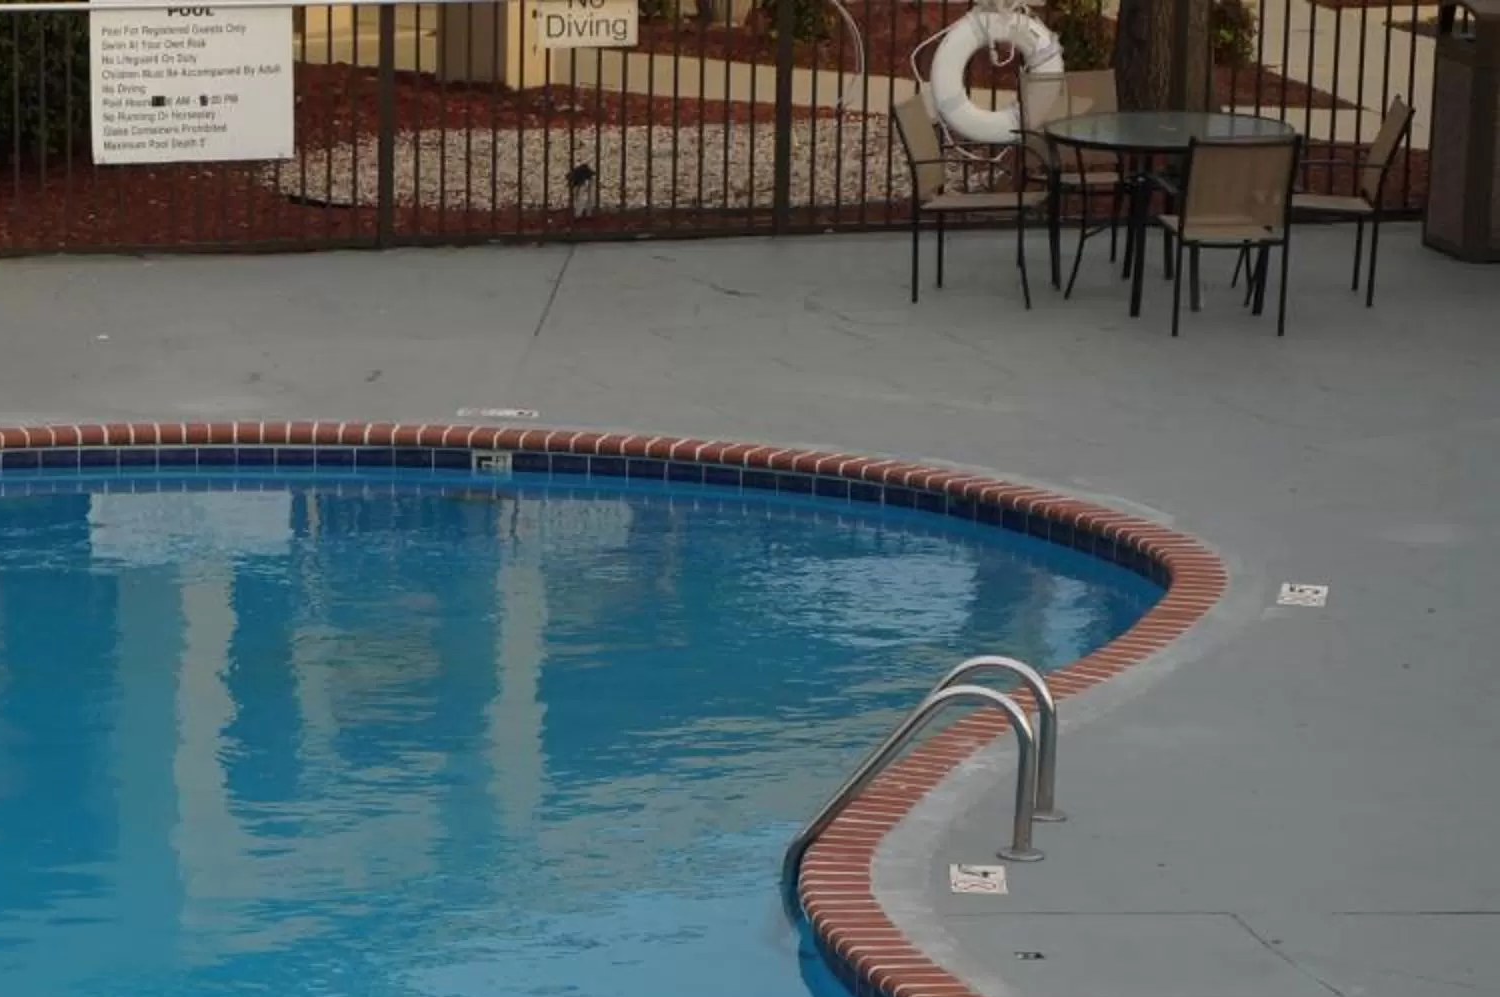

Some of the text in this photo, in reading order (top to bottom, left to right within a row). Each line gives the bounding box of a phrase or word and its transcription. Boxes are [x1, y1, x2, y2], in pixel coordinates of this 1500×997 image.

[167, 7, 215, 17] POOL
[142, 25, 189, 37] Registered
[191, 24, 224, 34] Guests
[546, 14, 628, 41] Diving
[116, 55, 158, 66] Lifeguard
[117, 83, 147, 95] Diving
[117, 111, 156, 123] Running
[172, 110, 216, 121] Horseplay
[131, 125, 179, 136] Containers
[181, 123, 227, 133] Prohibited
